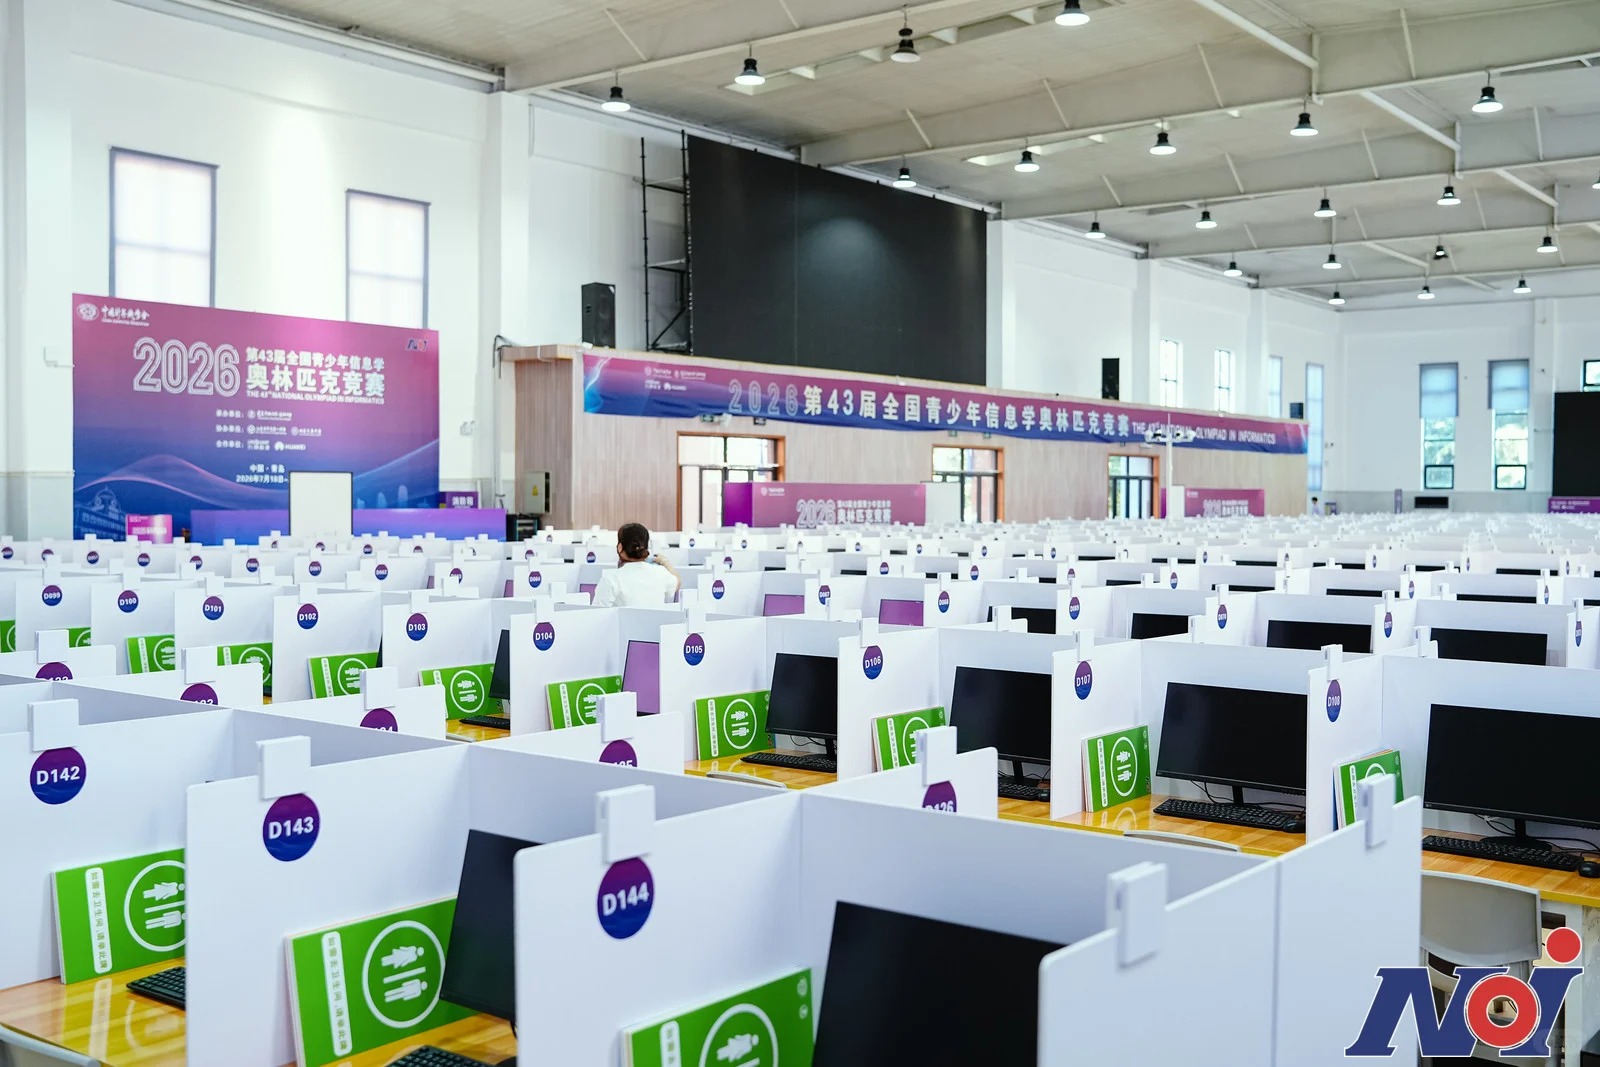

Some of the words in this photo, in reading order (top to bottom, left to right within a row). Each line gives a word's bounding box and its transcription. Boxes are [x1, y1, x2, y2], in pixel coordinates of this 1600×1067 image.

[246, 346, 385, 372] 第43届全国青少年信息学
[133, 336, 241, 397] 2026
[246, 363, 385, 397] 奥林匹克竞赛
[272, 391, 304, 400] NATIONAL
[305, 394, 336, 402] OLYMPIAD
[344, 396, 384, 404] INFORMATICS
[728, 379, 798, 416] 2026
[803, 385, 1129, 437] 第43届全国青少年信息学奥林匹克竞赛
[1132, 422, 1146, 434] THE
[1196, 427, 1227, 440] OLYMPIAD
[1229, 430, 1236, 441] IN
[1238, 430, 1276, 444] INFORMATICS
[796, 499, 836, 528] 2026
[43, 592, 61, 600] D099
[119, 597, 137, 606] D100
[204, 604, 222, 612] D101
[299, 613, 316, 621] D102
[408, 623, 426, 632] D103
[535, 632, 553, 641] D104
[685, 645, 703, 654] D105
[865, 656, 882, 668] D106
[1076, 674, 1091, 687] D107
[1328, 696, 1341, 707] D108
[36, 765, 81, 785] D142
[268, 816, 314, 840] D143
[602, 881, 650, 917] D144
